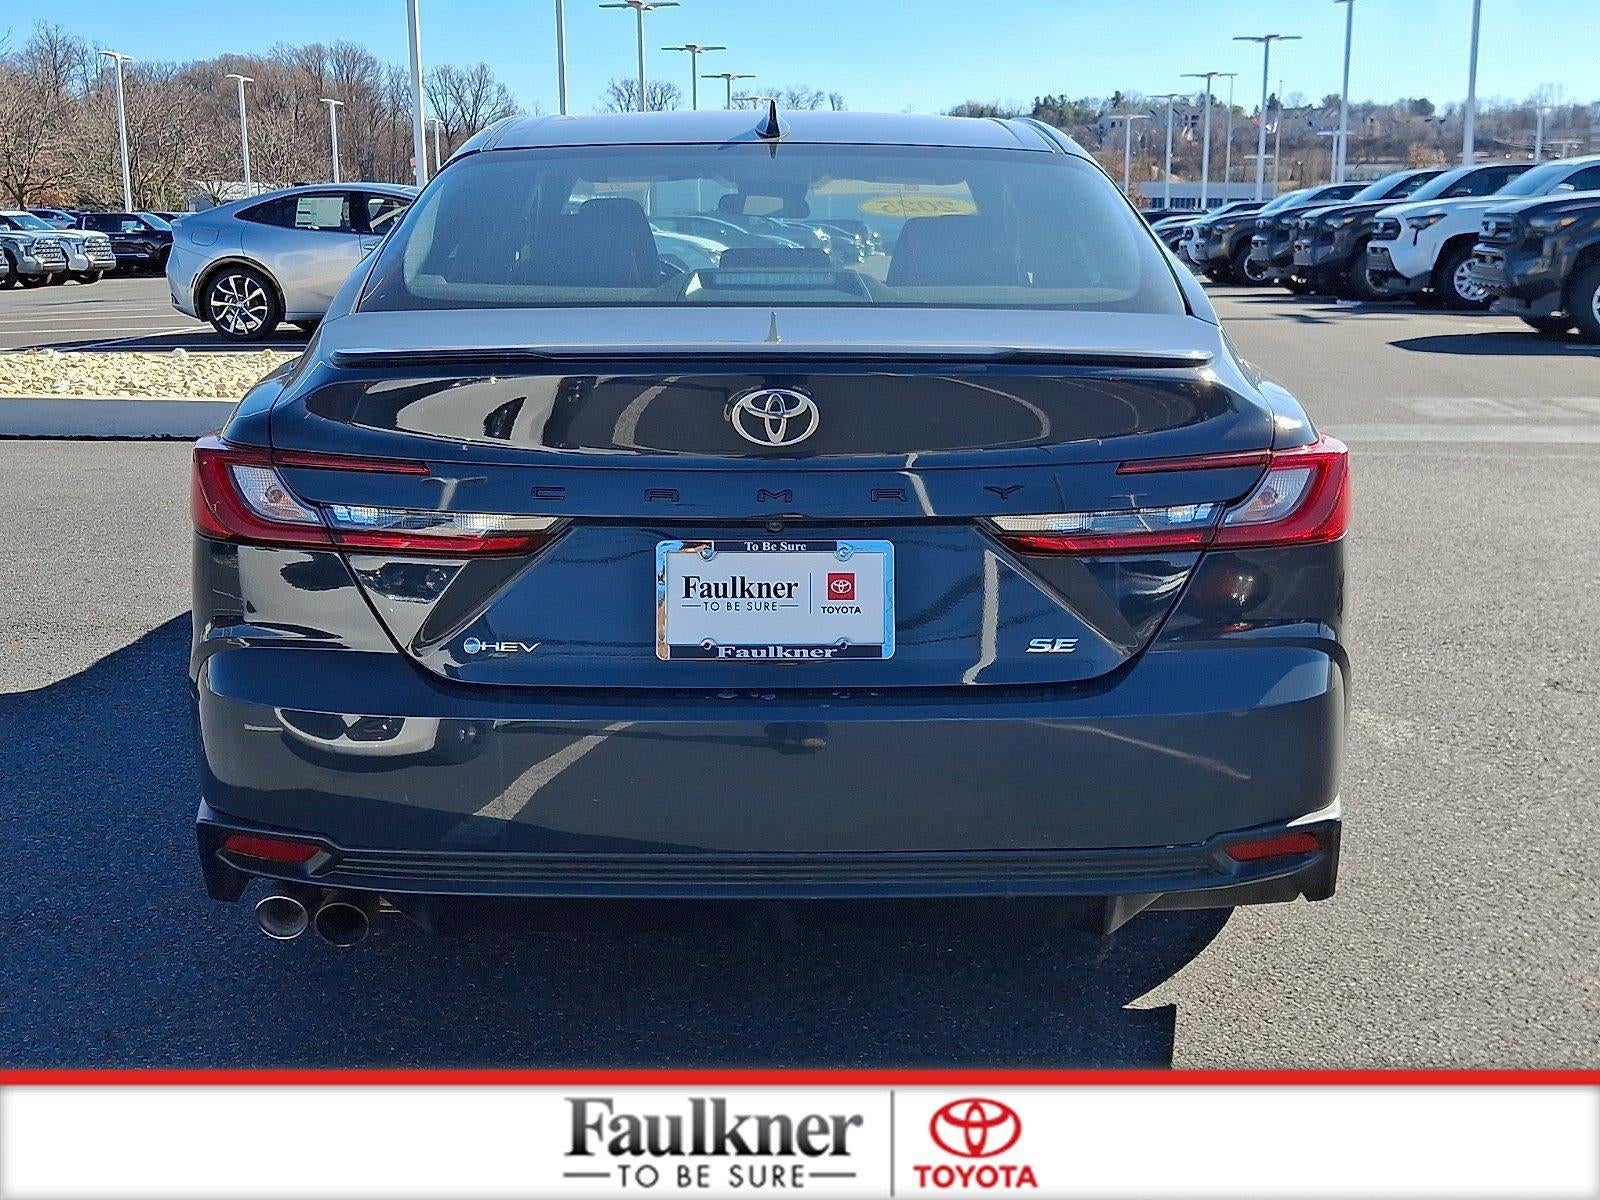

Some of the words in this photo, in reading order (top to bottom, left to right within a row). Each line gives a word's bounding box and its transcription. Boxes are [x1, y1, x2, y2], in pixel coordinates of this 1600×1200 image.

[531, 485, 1025, 503] CAMRY
[744, 541, 759, 551] To
[762, 541, 778, 551] Be
[780, 541, 807, 551] Sure
[682, 575, 799, 599] Faulkner
[703, 601, 720, 611] TO
[726, 601, 740, 611] BE
[746, 601, 778, 611] SURE
[821, 605, 862, 614] TOYOTA
[481, 641, 541, 653] HEV
[1026, 638, 1079, 653] SE
[716, 646, 838, 658] Faulkner
